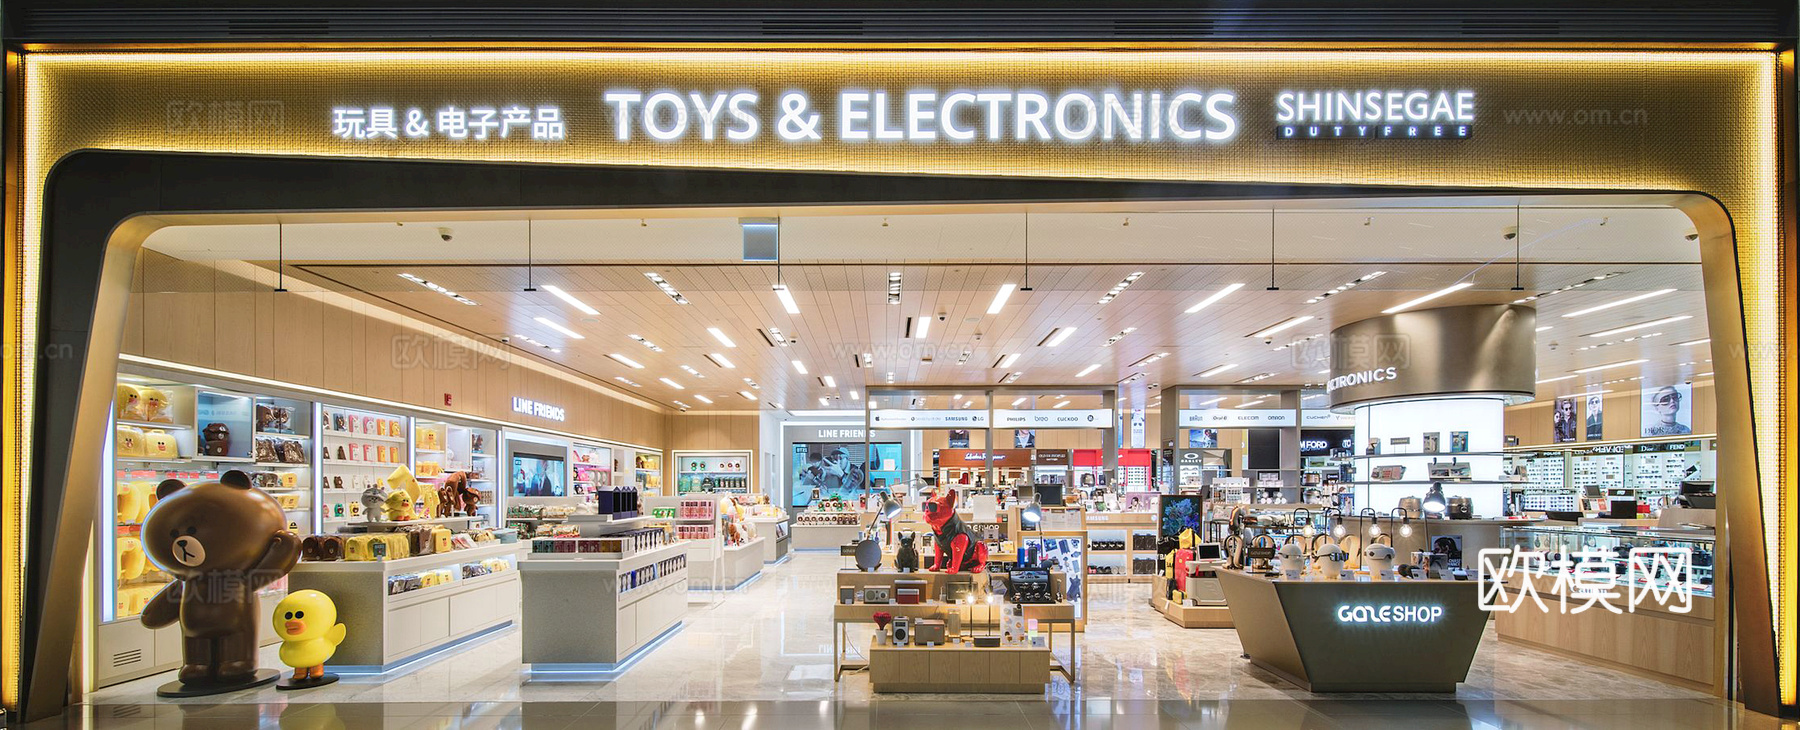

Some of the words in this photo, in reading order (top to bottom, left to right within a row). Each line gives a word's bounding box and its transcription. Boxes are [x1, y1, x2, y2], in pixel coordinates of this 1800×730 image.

[605, 92, 759, 140] TOYS
[777, 92, 823, 140] &
[840, 92, 1236, 140] ELECTRONICS
[1277, 92, 1475, 121] SHINSEGAE
[334, 108, 399, 140] 玩具
[405, 109, 431, 138] &
[438, 107, 565, 140] 电子产品
[1284, 126, 1367, 137] DUTY
[1384, 126, 1466, 137] FREE
[512, 396, 534, 416] LINE
[533, 401, 565, 422] FRIENDS
[818, 429, 838, 438] LINE
[840, 429, 876, 438] FRIENS
[1306, 440, 1328, 449] FORD
